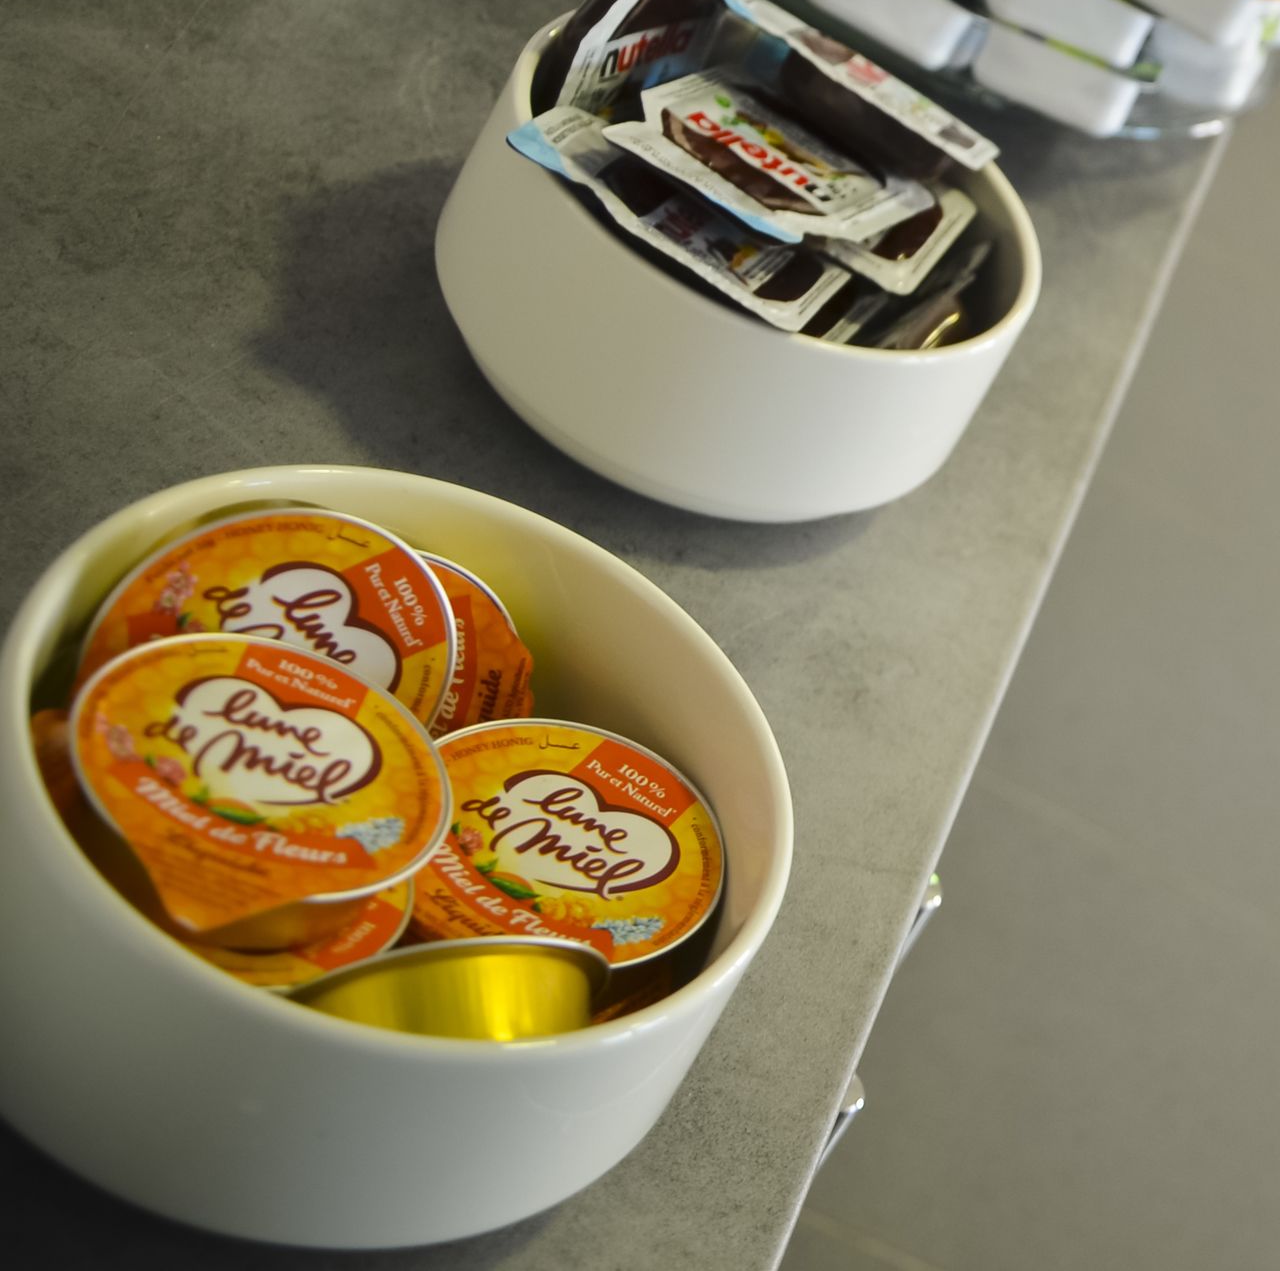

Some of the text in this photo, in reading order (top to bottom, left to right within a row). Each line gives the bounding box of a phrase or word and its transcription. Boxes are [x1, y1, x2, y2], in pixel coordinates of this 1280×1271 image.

[600, 26, 693, 78] nutella
[686, 111, 831, 203] nutella
[365, 562, 383, 590] Pur
[203, 585, 252, 632] de
[143, 714, 198, 755] de
[493, 736, 534, 750] HONIG
[586, 758, 611, 780] Pur
[609, 776, 622, 789] et
[460, 795, 512, 832] de
[251, 830, 349, 866] Fleurs
[434, 842, 486, 896] Miel
[476, 890, 509, 917] de
